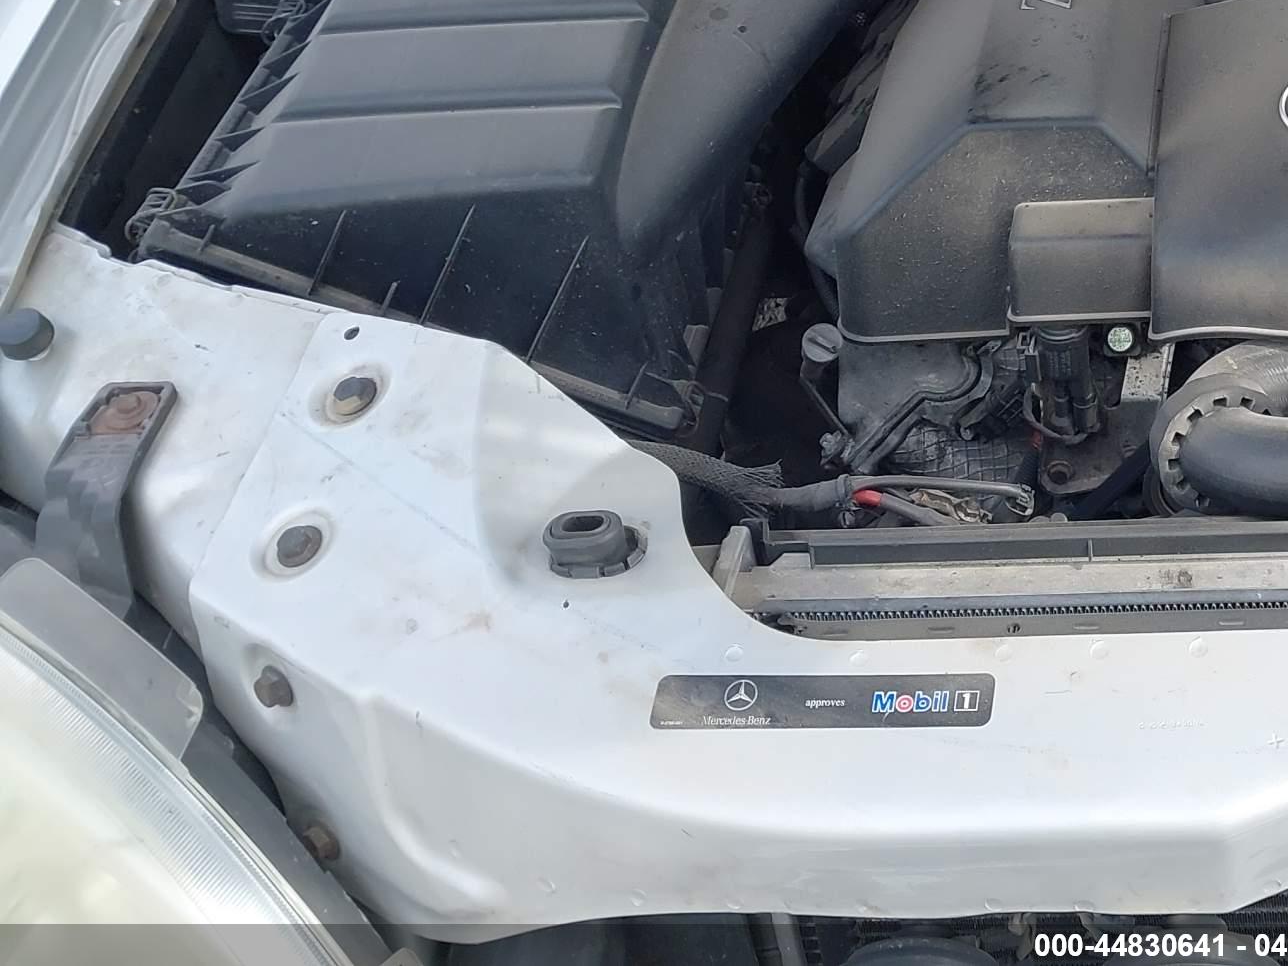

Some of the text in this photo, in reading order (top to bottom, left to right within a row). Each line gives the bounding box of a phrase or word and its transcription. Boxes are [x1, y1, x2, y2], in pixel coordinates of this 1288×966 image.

[805, 698, 846, 709] approves
[871, 691, 949, 713] Mobil
[702, 715, 771, 726] Mercedes-Benz
